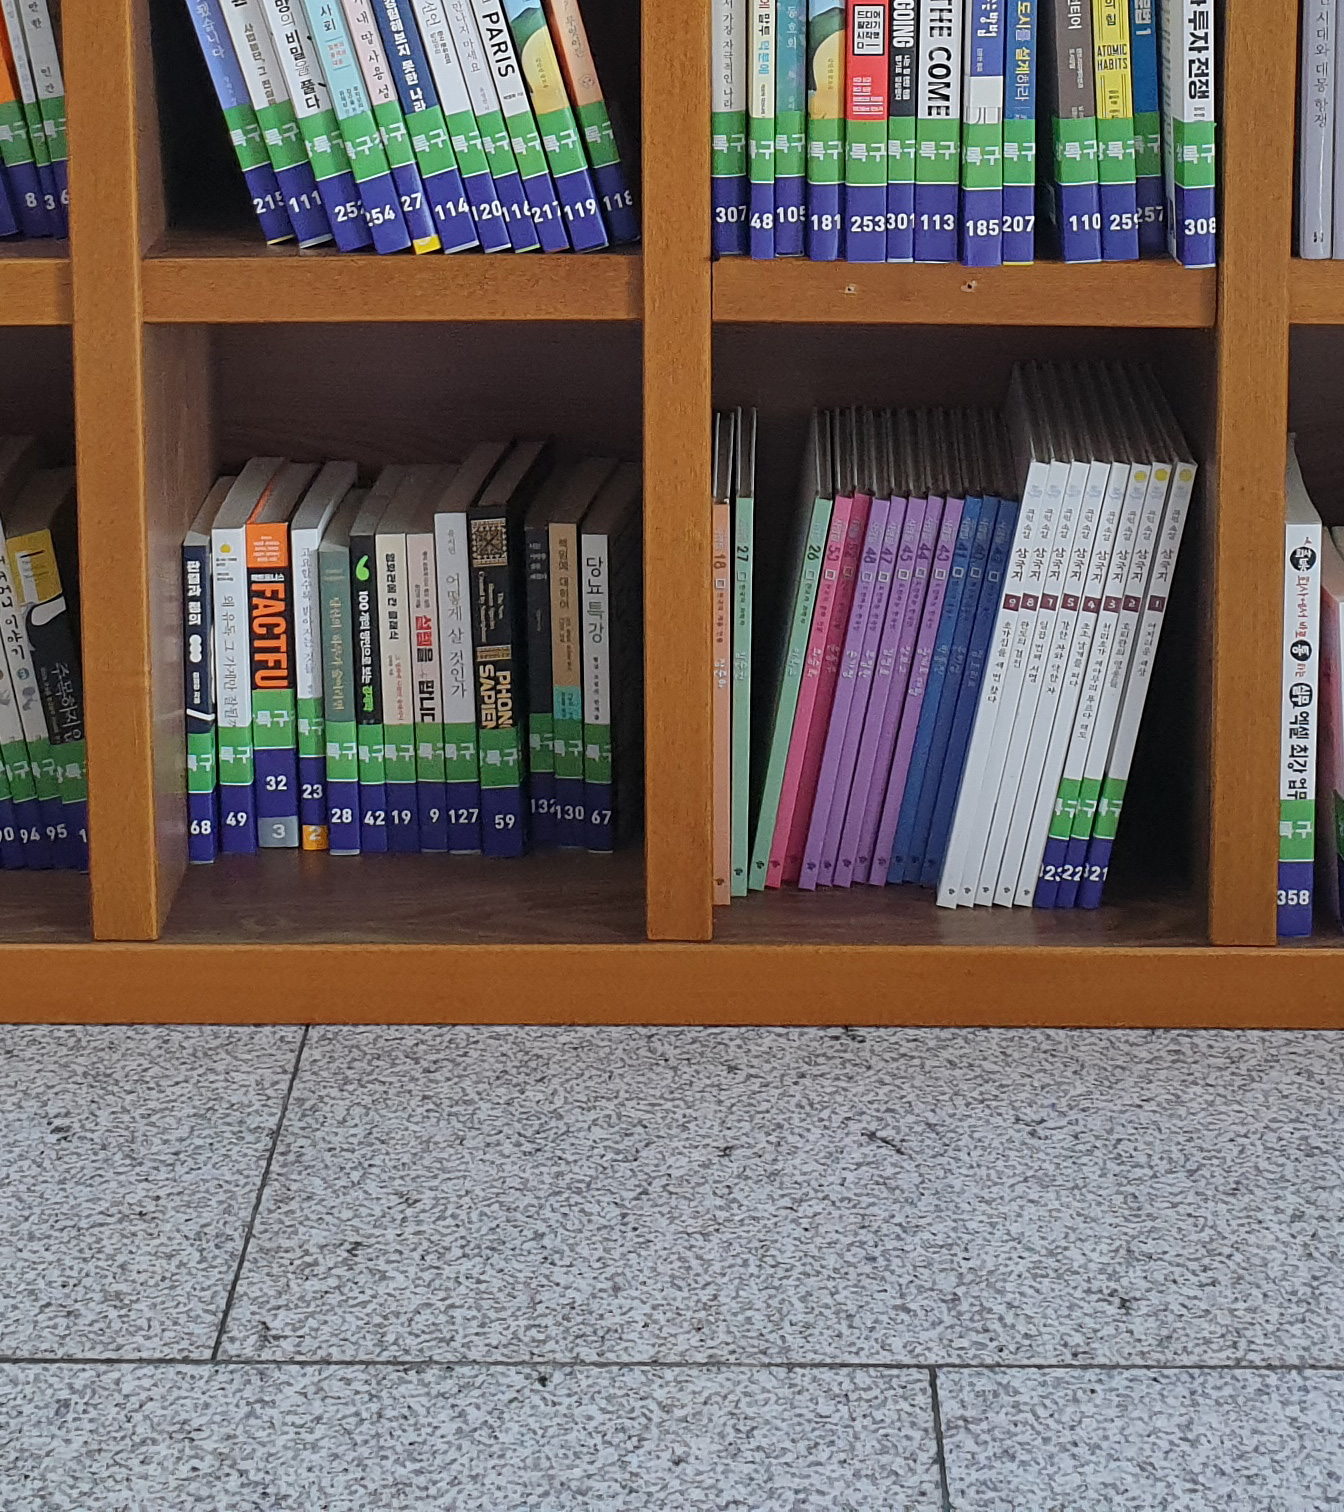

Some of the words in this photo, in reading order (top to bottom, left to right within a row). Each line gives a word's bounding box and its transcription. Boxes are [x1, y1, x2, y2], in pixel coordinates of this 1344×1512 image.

[421, 0, 441, 27] 선언
[893, 0, 915, 48] GOING
[1188, 10, 1209, 53] 투자
[482, 11, 516, 78] PARIS
[1097, 44, 1127, 56] ATOMIC
[401, 60, 419, 85] 못한
[1097, 58, 1128, 70] HABITS
[927, 46, 952, 117] COME
[1188, 57, 1210, 100] 전쟁
[409, 89, 426, 112] 나라
[289, 192, 321, 213] 111
[401, 193, 422, 211] 27
[435, 200, 468, 221] 114
[564, 199, 597, 220] 119
[851, 216, 885, 233] 253
[921, 215, 954, 231] 113
[966, 219, 999, 236] 185
[1002, 215, 1035, 232] 207
[1011, 547, 1028, 582] 삼국지
[1029, 547, 1046, 581] 삼국지
[1049, 547, 1066, 581] 삼국지
[1070, 547, 1087, 581] 삼국지
[1091, 550, 1109, 584] 삼국지
[1112, 549, 1129, 583] 삼국지
[1131, 548, 1149, 583] 삼국지
[586, 556, 604, 595] 당뇨
[586, 601, 605, 644] 특강
[251, 582, 288, 687] FACTFU
[266, 775, 287, 790] 32
[302, 784, 323, 799] 23
[226, 812, 247, 827] 49
[331, 809, 353, 824] 28
[364, 810, 386, 825] 42
[391, 810, 411, 825] 19
[449, 808, 479, 824] 127
[494, 814, 515, 830] 59
[591, 810, 612, 825] 67
[20, 829, 40, 843] 94
[46, 824, 67, 841] 95
[190, 820, 211, 834] 68
[1277, 890, 1309, 906] 358
